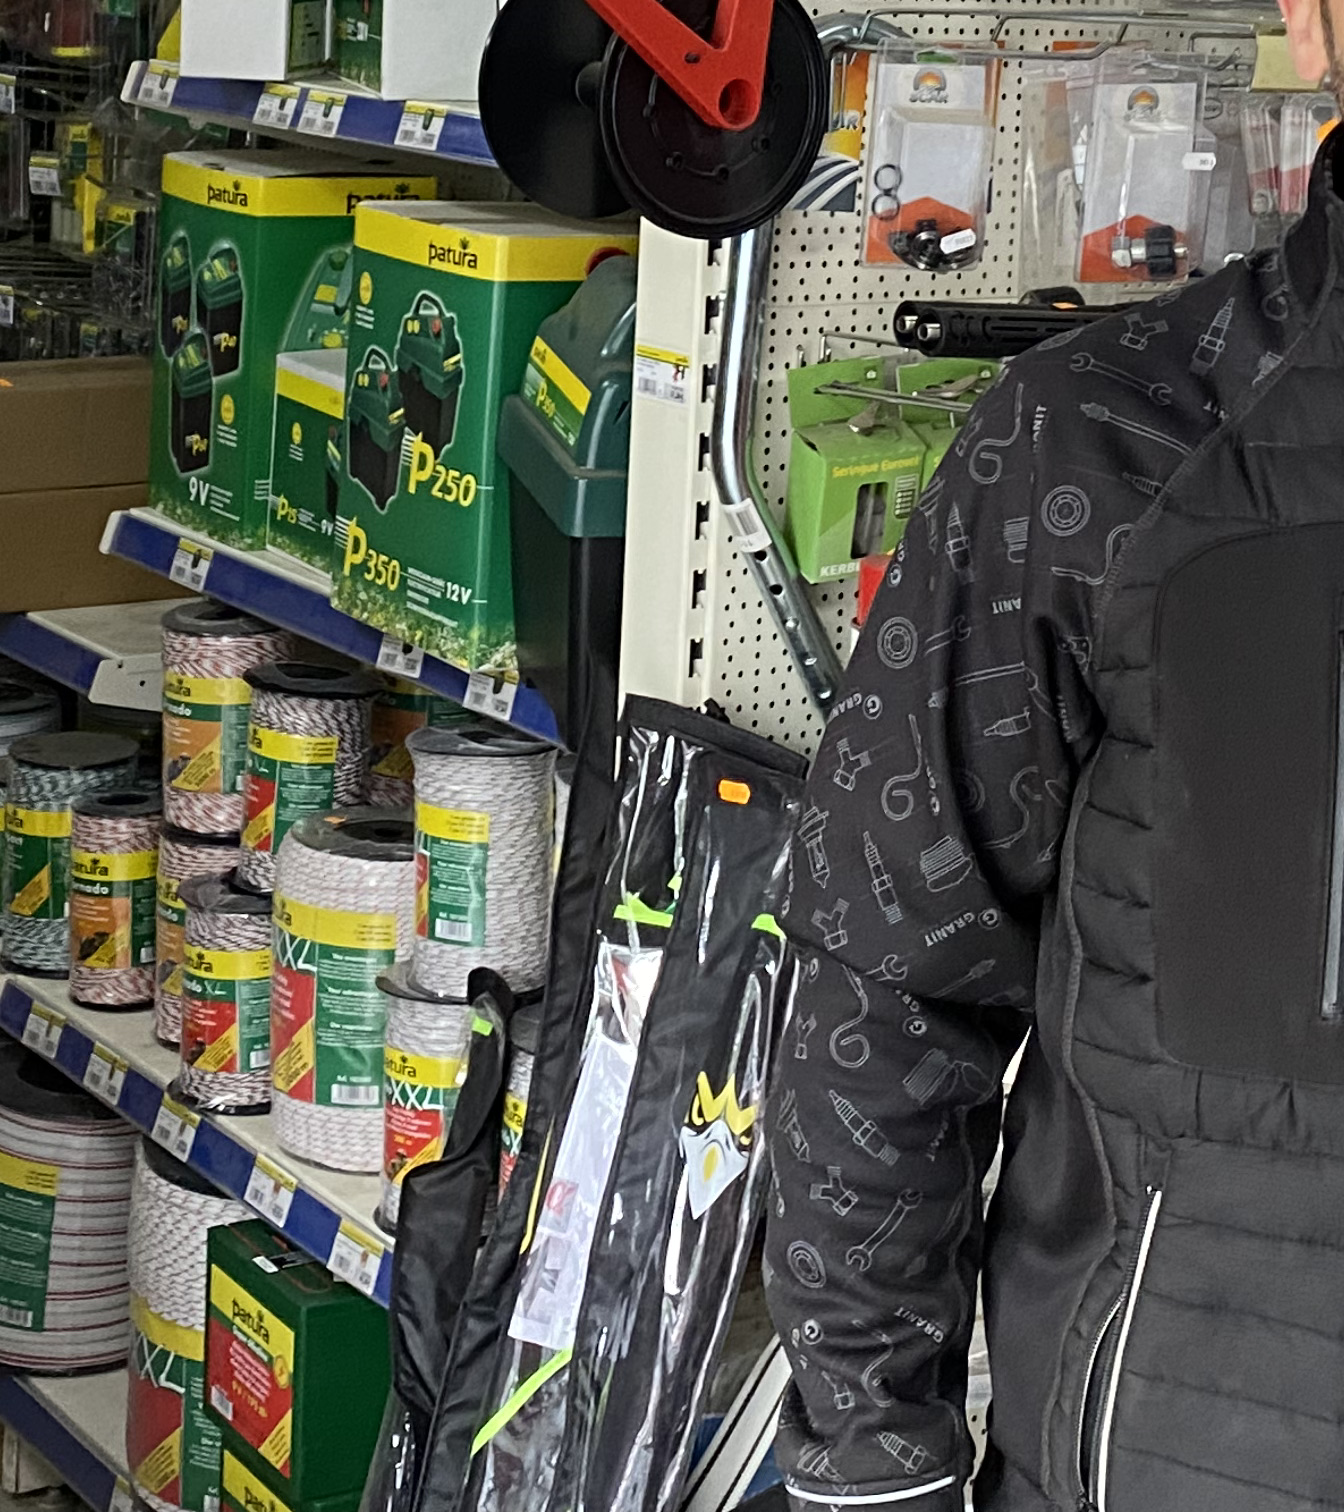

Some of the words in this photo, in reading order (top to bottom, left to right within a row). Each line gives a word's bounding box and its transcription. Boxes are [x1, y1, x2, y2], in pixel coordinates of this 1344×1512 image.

[207, 185, 248, 207] patura
[428, 240, 478, 270] patura
[408, 431, 478, 508] P250
[189, 476, 210, 506] 9V
[321, 517, 334, 536] 9V
[343, 516, 400, 591] P350
[446, 580, 472, 604] 12V
[925, 911, 975, 947] GRANIT
[391, 1079, 444, 1112] XXL
[232, 1297, 270, 1345] patura
[894, 1305, 945, 1345] GRANIT
